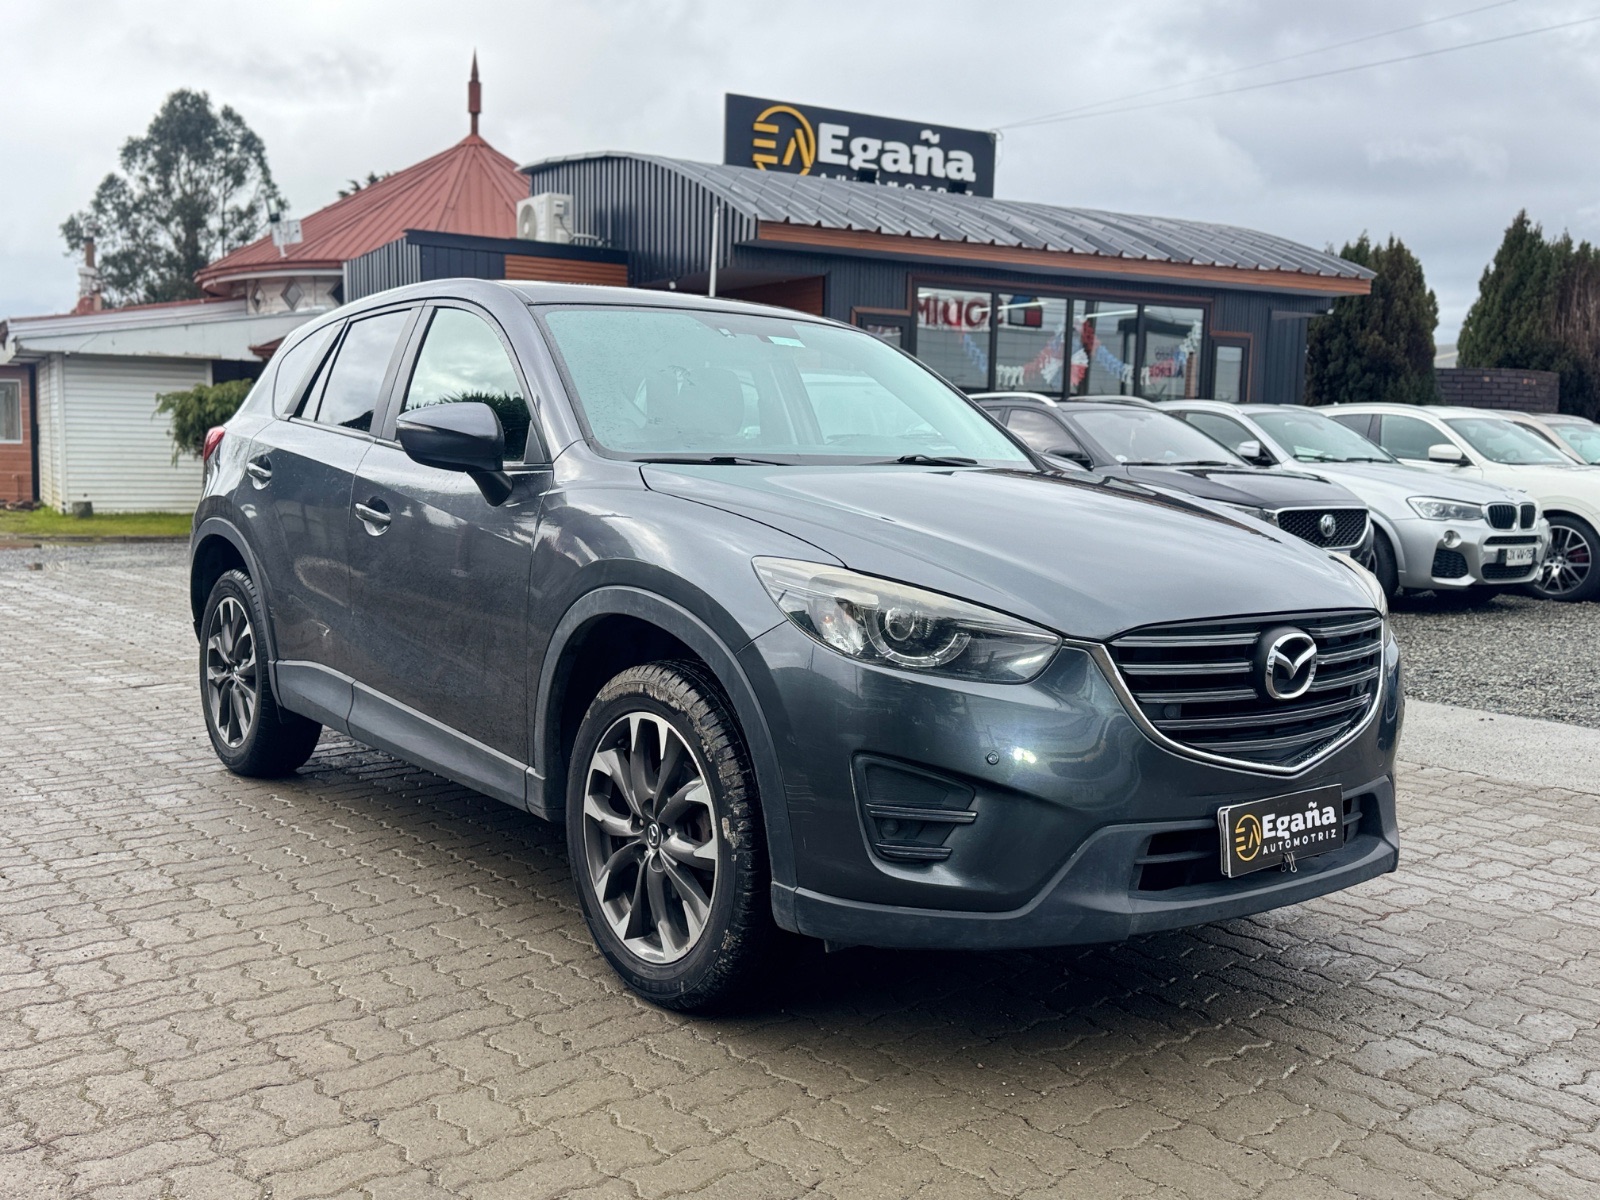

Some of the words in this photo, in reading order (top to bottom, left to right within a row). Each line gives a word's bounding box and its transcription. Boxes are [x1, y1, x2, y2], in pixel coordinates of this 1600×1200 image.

[817, 121, 977, 183] Egaña
[1261, 801, 1337, 840] Egaña
[1262, 829, 1337, 855] AUTOMOTRIZ
